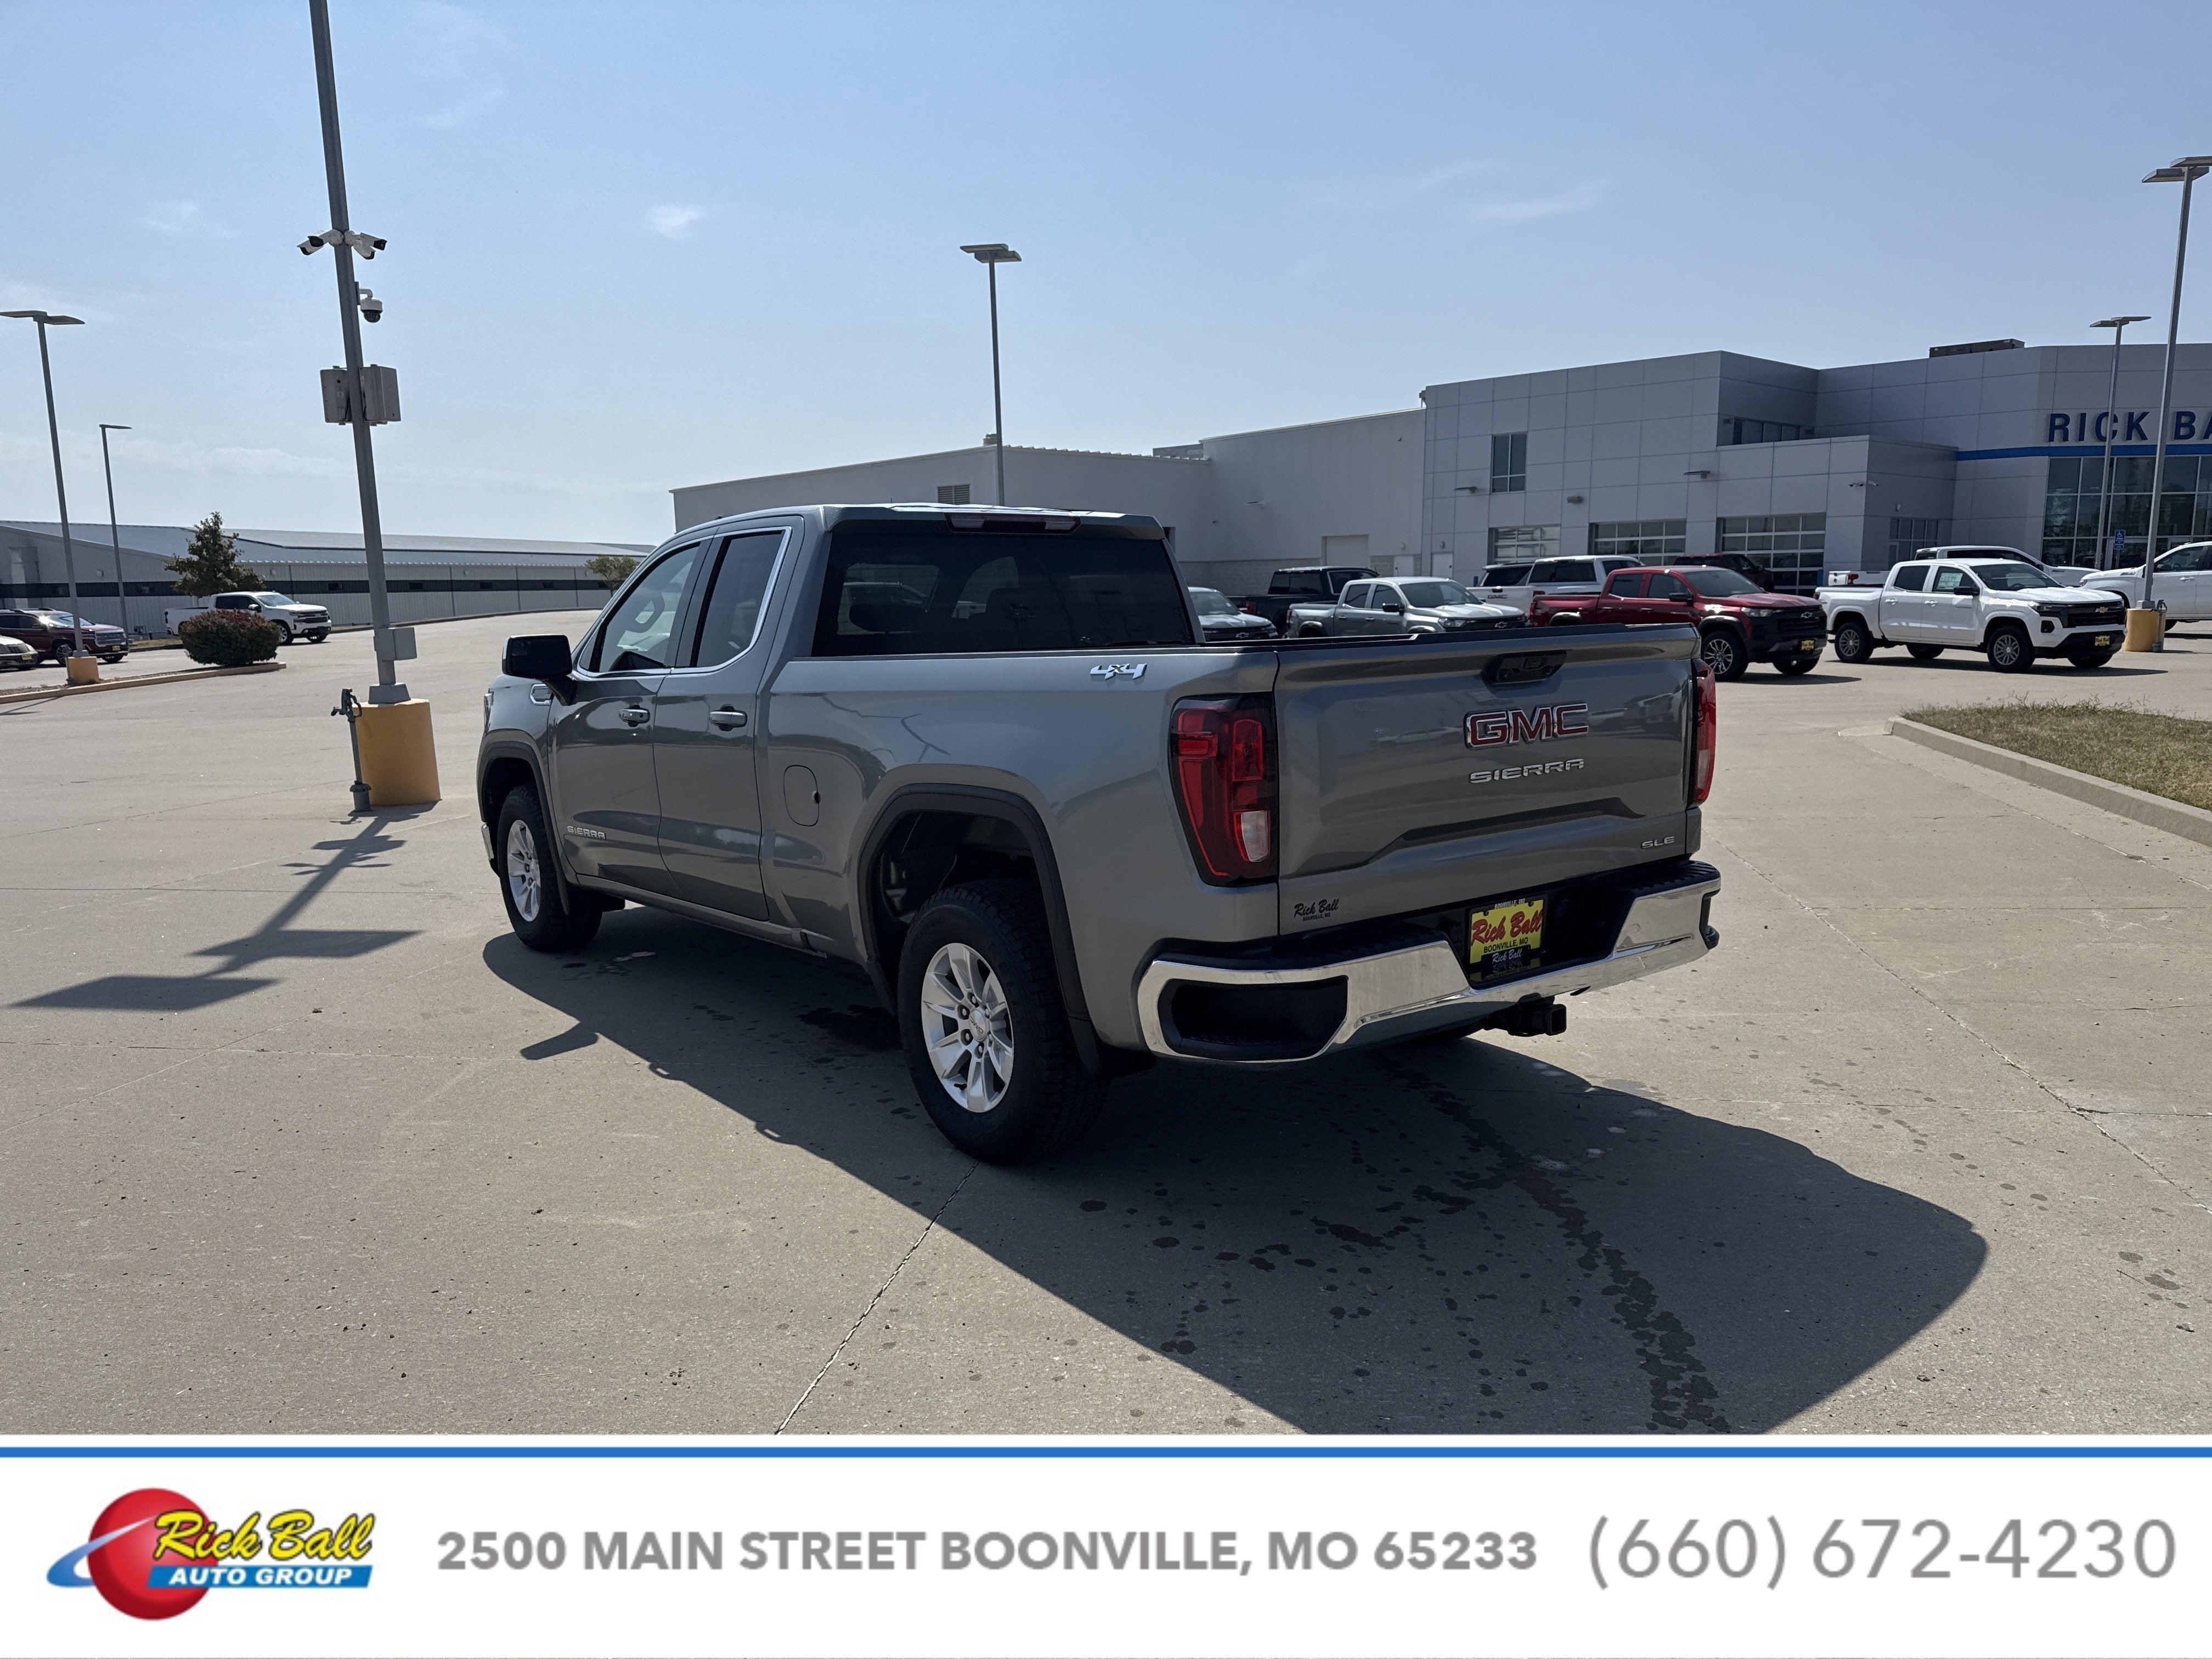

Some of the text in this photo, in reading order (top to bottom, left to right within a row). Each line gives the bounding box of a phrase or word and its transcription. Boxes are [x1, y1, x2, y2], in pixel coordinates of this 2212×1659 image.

[2048, 411, 2150, 442] RICK
[1465, 703, 1588, 749] GMC
[1469, 758, 1584, 783] SIERRA
[567, 826, 606, 839] SIERRA
[1641, 836, 1675, 849] SLE
[1294, 898, 1339, 918] Rick Ball
[1470, 909, 1543, 946] Rick Ball
[1483, 939, 1518, 953] BOONVILLE,
[1492, 948, 1522, 964] Rick Ball
[970, 1016, 984, 1034] GMC
